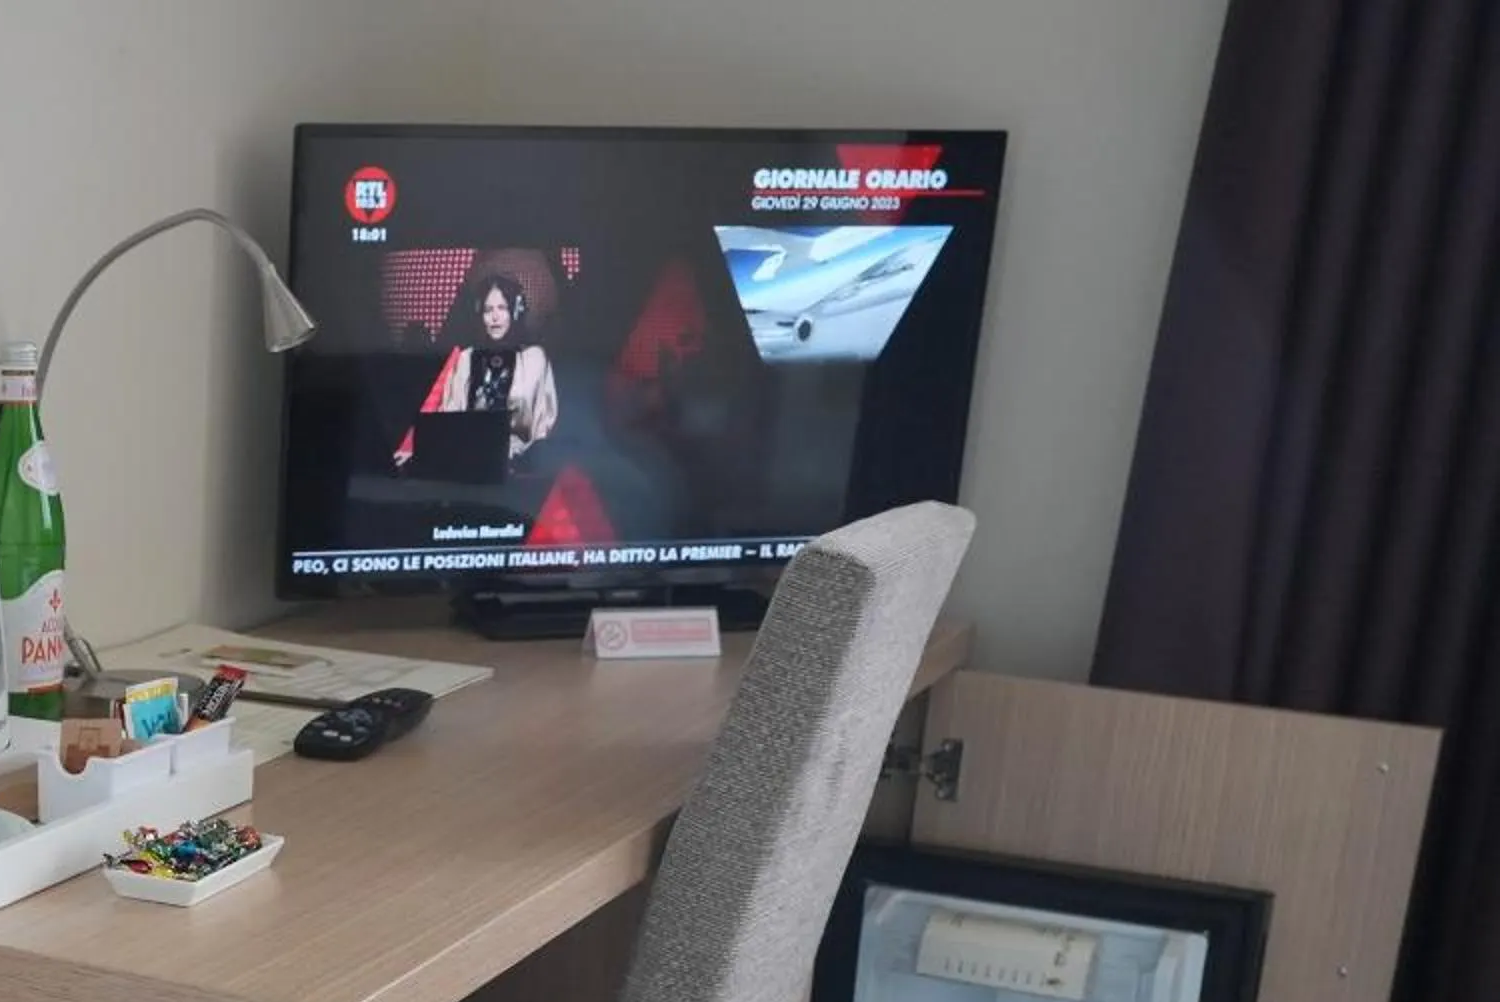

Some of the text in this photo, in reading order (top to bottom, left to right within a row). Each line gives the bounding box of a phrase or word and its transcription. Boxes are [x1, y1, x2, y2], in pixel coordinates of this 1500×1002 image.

[753, 168, 948, 189] GIORNALE ORARIO
[355, 181, 386, 197] RTL
[802, 196, 818, 210] 29
[820, 196, 869, 210] GIUGNO
[870, 196, 900, 210] 2023
[292, 558, 328, 575] PEO,
[333, 558, 348, 573] CI
[351, 556, 400, 573] SONO
[403, 555, 421, 571] LE
[423, 553, 505, 570] POSIZIONI
[508, 550, 580, 569] ITALIANE,
[583, 548, 606, 564] HA
[608, 546, 657, 564] DETTO
[659, 545, 679, 562] LA
[681, 544, 742, 561] PREMIER
[759, 543, 773, 559] IL
